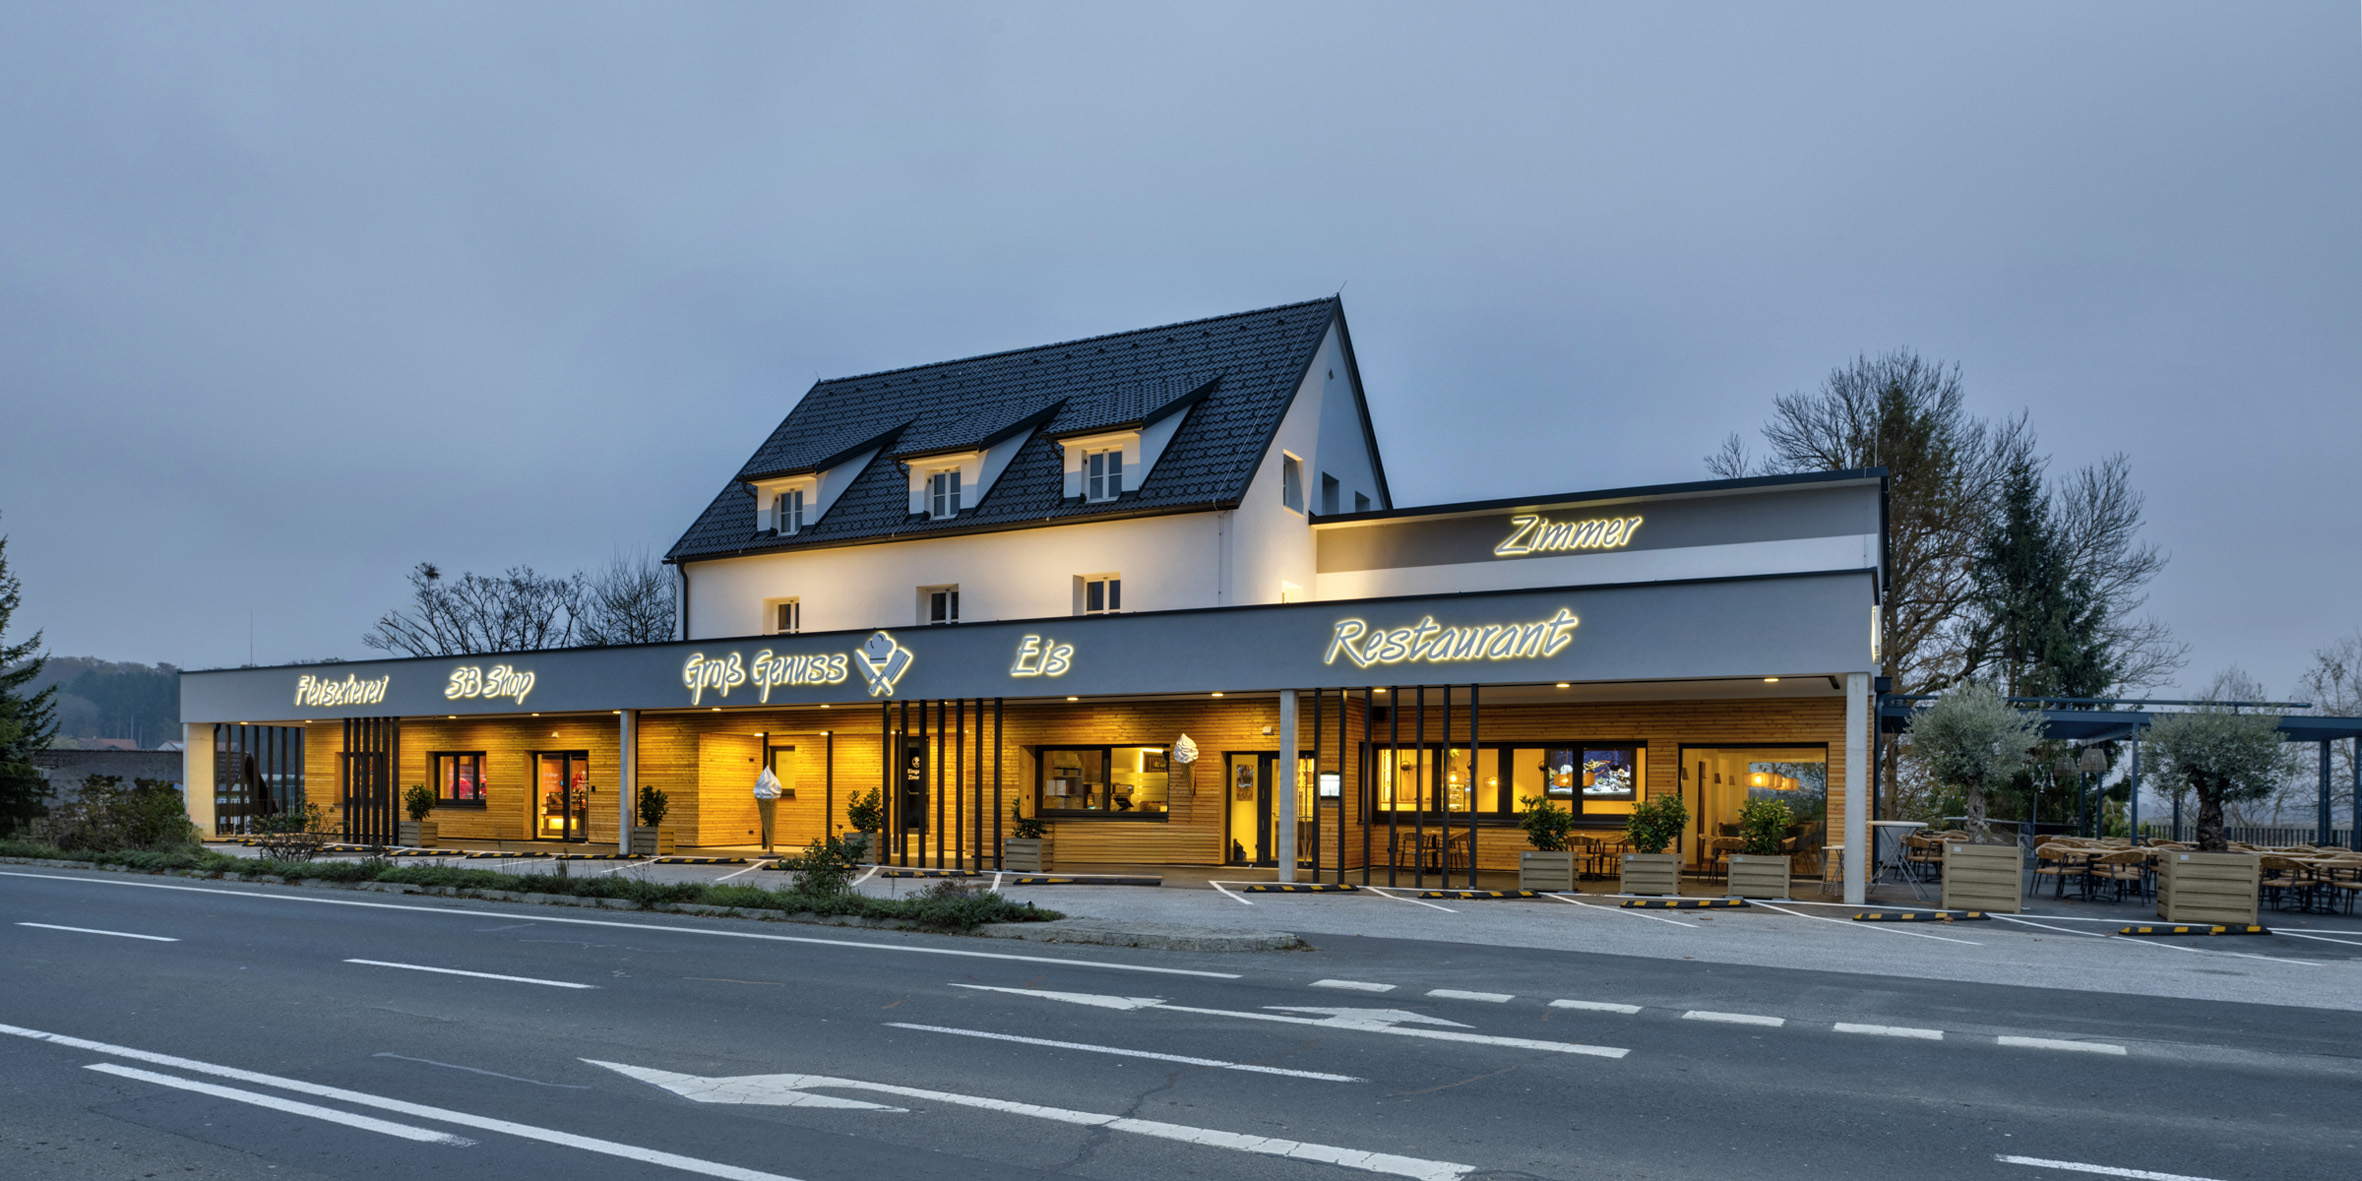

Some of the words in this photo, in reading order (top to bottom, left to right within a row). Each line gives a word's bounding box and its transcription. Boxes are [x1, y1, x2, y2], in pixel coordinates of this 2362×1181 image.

[1495, 515, 1642, 555] Zimmer
[1009, 635, 1074, 677] Eis
[1323, 608, 1579, 667] Restaurant
[294, 673, 389, 706] Fleischerei
[444, 666, 482, 699] SB
[482, 665, 535, 705] Shop
[682, 653, 745, 705] Groß
[750, 650, 848, 704] Genuss
